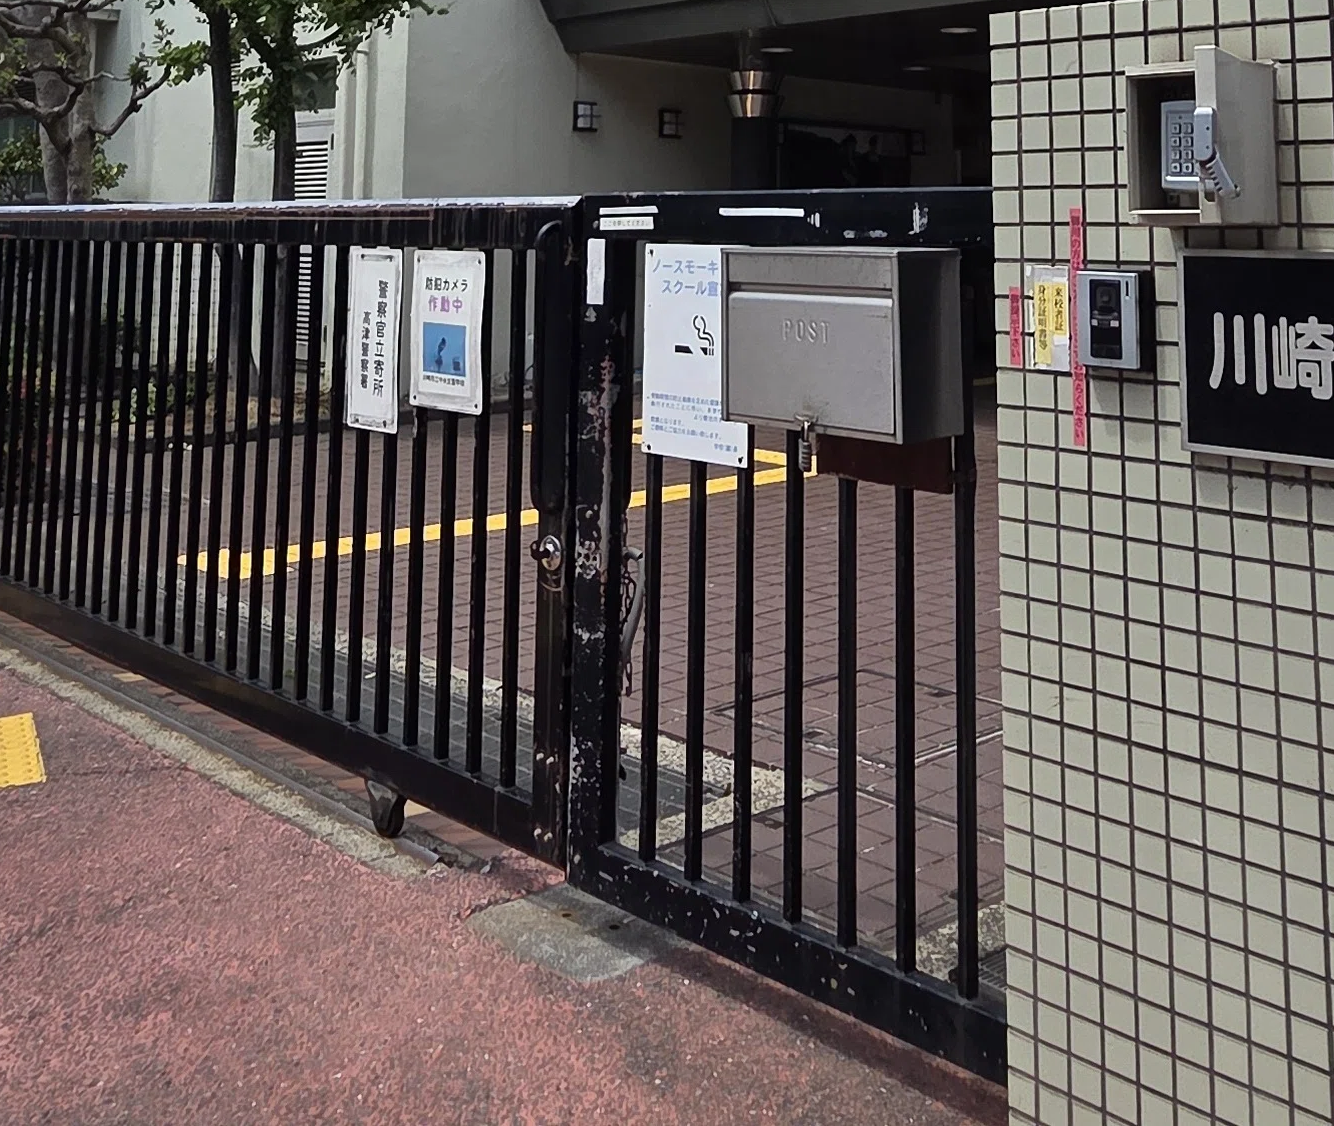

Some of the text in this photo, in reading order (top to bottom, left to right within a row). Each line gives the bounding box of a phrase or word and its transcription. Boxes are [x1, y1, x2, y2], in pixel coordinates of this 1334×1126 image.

[652, 259, 719, 275] ノースモーキ
[425, 277, 468, 292] 防犯カメラ
[428, 295, 463, 314] 作動中
[373, 279, 389, 398] 警察官立寄所
[782, 319, 831, 344] POST
